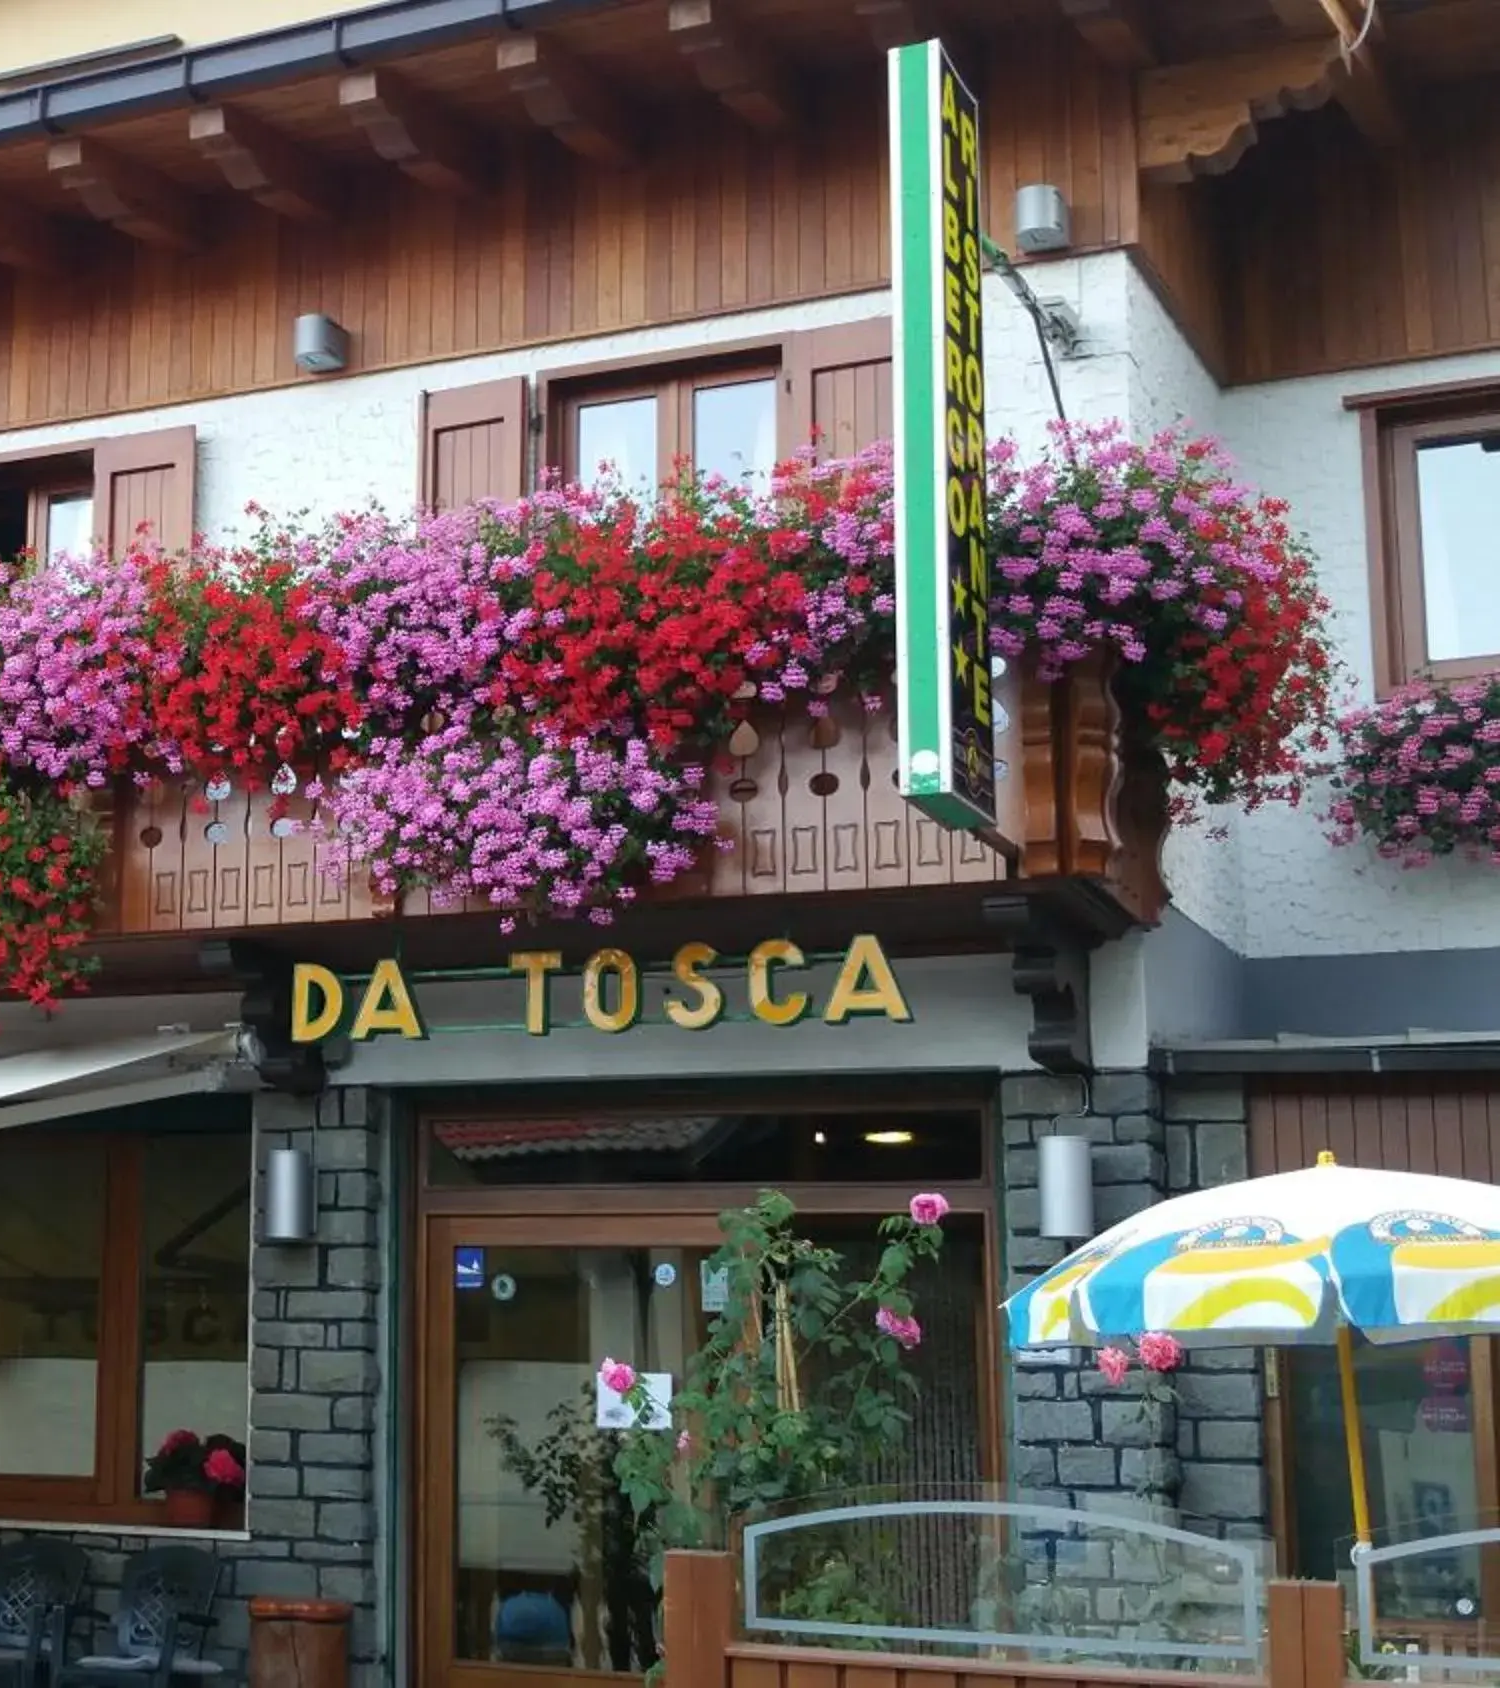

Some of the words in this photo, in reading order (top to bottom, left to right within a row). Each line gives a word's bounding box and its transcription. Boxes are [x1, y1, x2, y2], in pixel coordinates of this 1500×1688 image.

[941, 72, 967, 537] ALBERGO
[960, 110, 990, 727] RISTORANTE
[291, 958, 424, 1042] DA
[509, 933, 912, 1034] TOSCA
